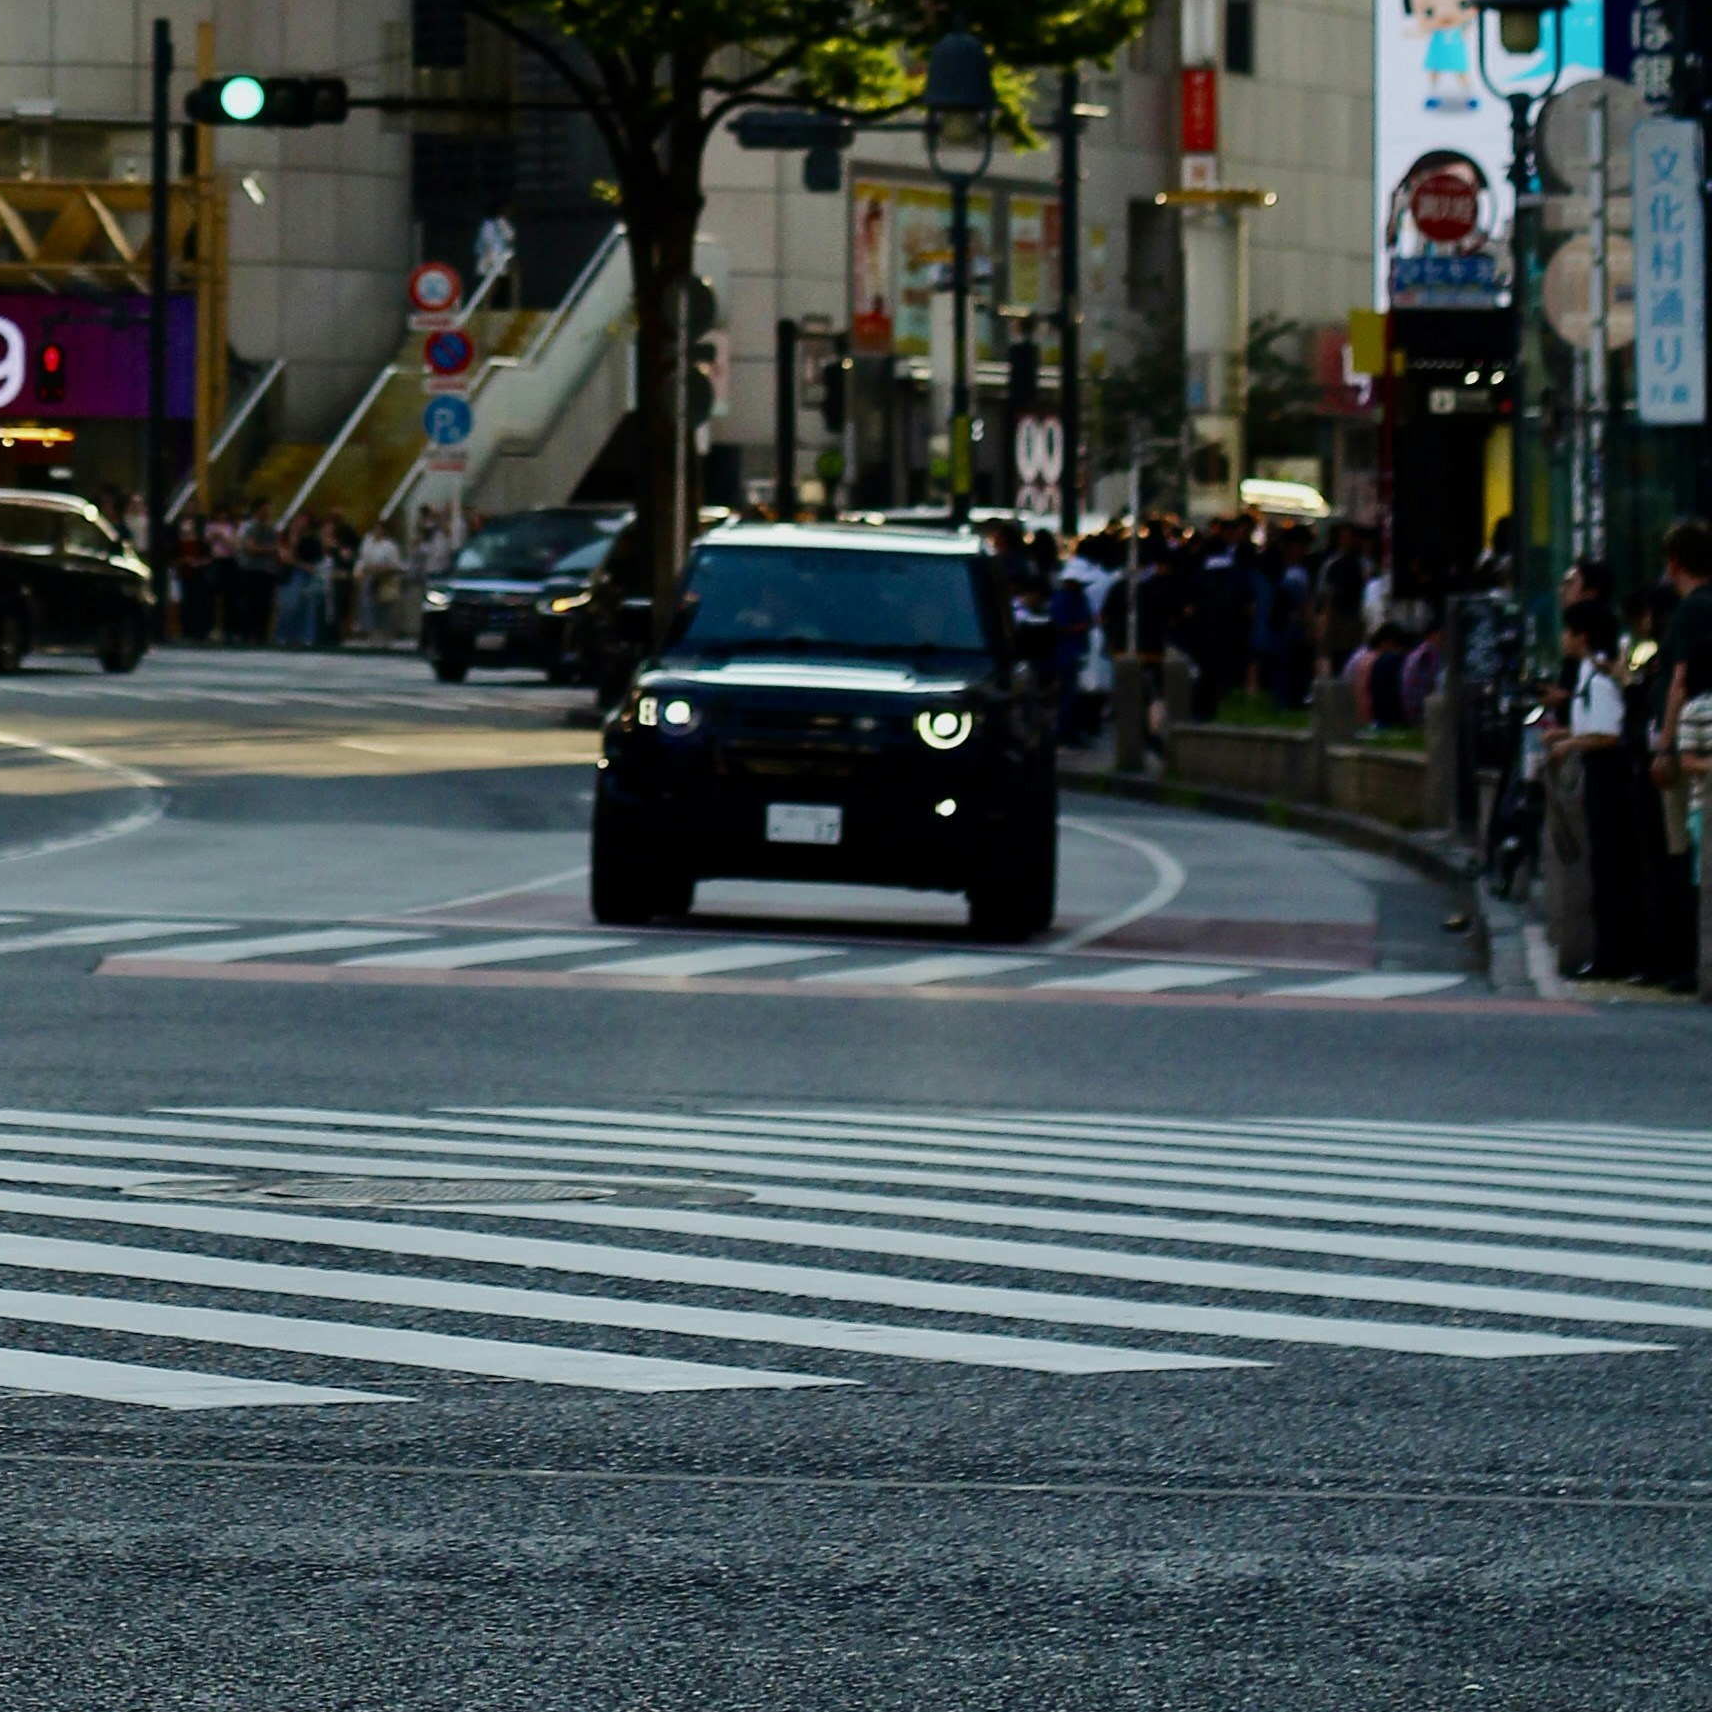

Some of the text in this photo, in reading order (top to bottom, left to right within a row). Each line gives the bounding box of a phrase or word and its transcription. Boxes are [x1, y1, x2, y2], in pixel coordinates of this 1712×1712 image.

[1649, 144, 1687, 377] 文化村通り
